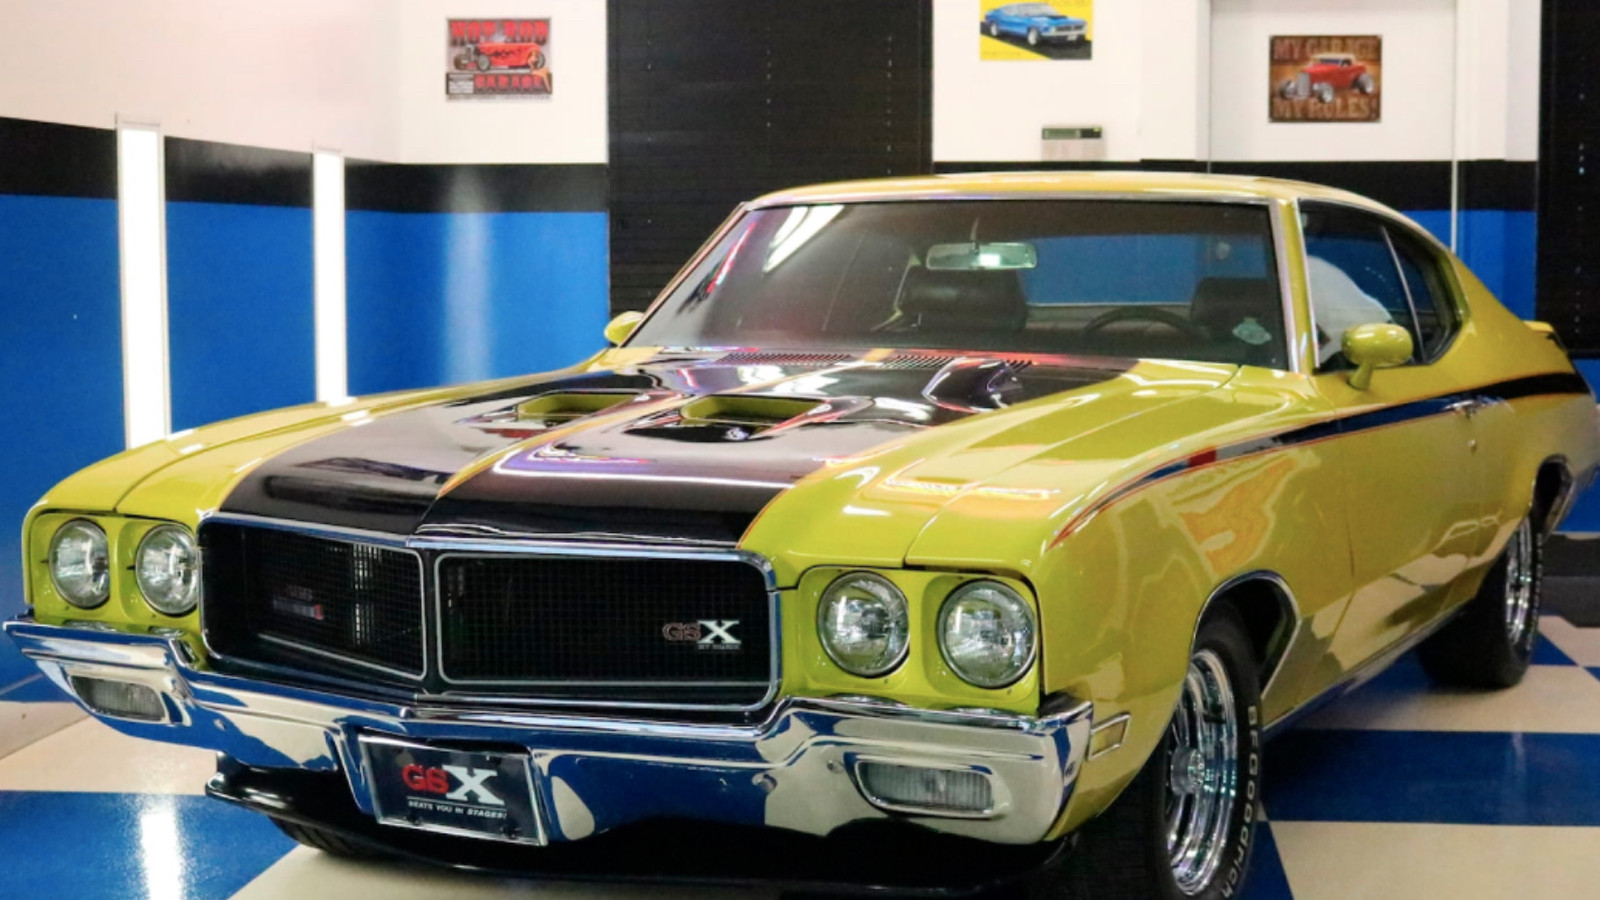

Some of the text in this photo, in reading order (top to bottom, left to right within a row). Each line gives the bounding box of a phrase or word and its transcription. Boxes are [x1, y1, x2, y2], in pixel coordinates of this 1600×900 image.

[1273, 39, 1302, 60] MY
[662, 620, 741, 644] GSX
[402, 763, 506, 806] GSX
[408, 800, 433, 810] BEATS
[436, 804, 453, 813] YOU
